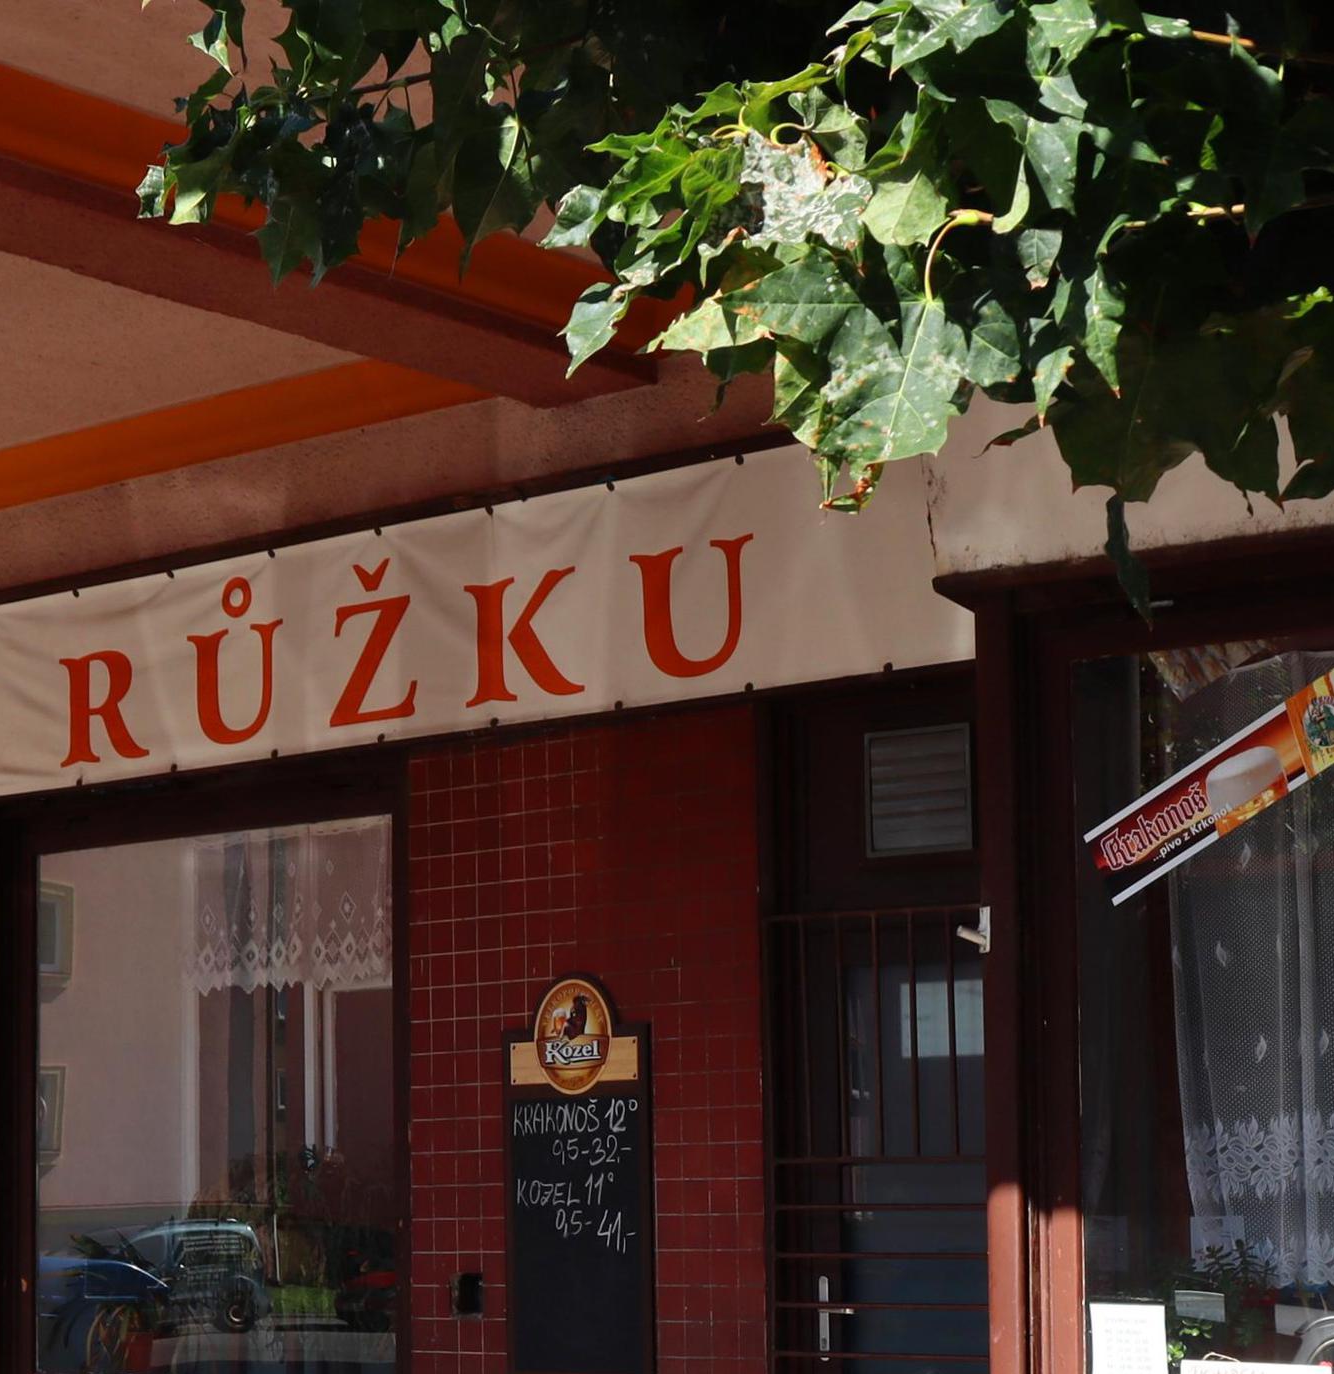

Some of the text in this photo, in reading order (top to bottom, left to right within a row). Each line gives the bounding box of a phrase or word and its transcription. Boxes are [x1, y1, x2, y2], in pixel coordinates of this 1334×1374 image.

[59, 533, 754, 768] RŮŽKU
[1100, 781, 1208, 871] Krakonoš
[1183, 831, 1191, 841] z
[545, 1040, 601, 1064] Kozel
[517, 1178, 581, 1207] KOZEL
